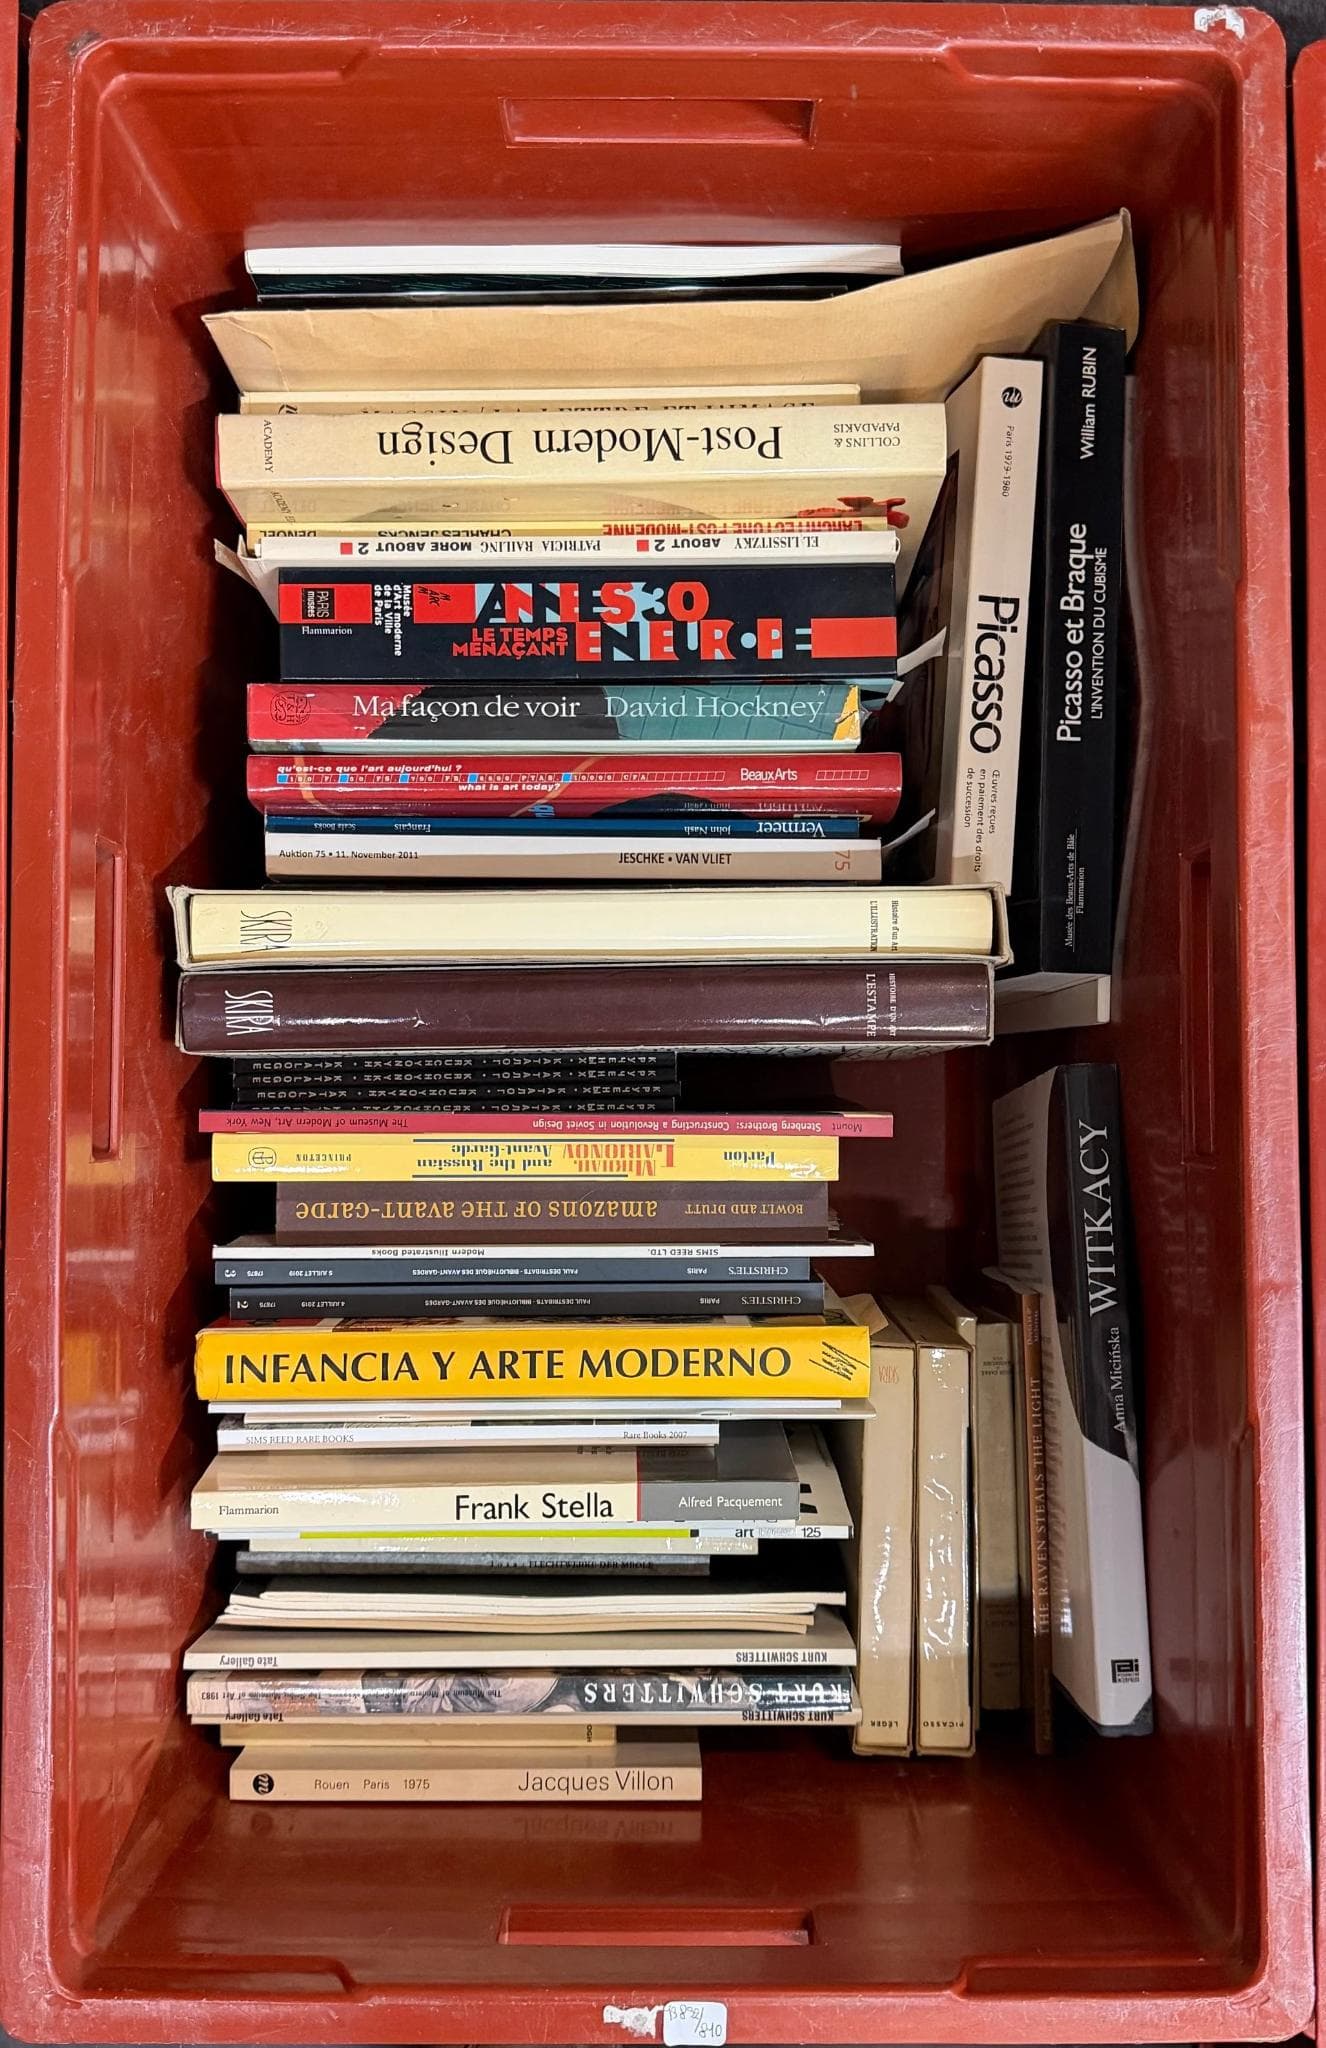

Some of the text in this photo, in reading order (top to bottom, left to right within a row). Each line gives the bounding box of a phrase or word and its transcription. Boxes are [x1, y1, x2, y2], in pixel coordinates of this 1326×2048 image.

[1080, 347, 1097, 459] William RUBIN
[833, 423, 900, 433] PAPADAKIS
[264, 419, 273, 473] ACADEMY
[376, 422, 783, 466] Post-Modern Design
[846, 437, 901, 448] COLLINS
[358, 542, 369, 555] 2
[375, 542, 425, 553] ABOUT
[428, 541, 472, 552] MORE
[542, 540, 601, 552] PATRICIA
[654, 539, 665, 552] 2
[672, 538, 721, 549] ABOUT
[734, 537, 799, 550] LISSITZKY
[801, 536, 819, 548] EL
[969, 425, 1020, 753] Paris 1979-1980 Picasso
[307, 591, 316, 618] musées
[316, 590, 330, 617] PARIS
[374, 600, 383, 626] Paris
[393, 584, 403, 657] d'Art moderne
[302, 626, 352, 636] Flammarion
[384, 612, 393, 635] Ville
[472, 627, 568, 641] LE TEMPS
[1056, 524, 1093, 741] Picasso et Braque
[1090, 548, 1107, 720] L'INVENTION DU CUBISME
[452, 642, 568, 660] MENAÇANT
[352, 693, 824, 723] Ma façon de voir David Hockney
[336, 766, 357, 774] que
[502, 783, 518, 791] art
[964, 782, 974, 828] succession
[987, 769, 1000, 834] Œuvres reçues
[394, 821, 826, 838] Vermeer John Nash Français
[974, 782, 986, 872] paiement droits
[279, 849, 418, 859] Auktion 75 11. November 2011
[618, 852, 732, 865] JESCHKE VAN VLIET
[833, 849, 850, 870] 75
[1065, 863, 1074, 904] Beaux-Arts
[1076, 867, 1085, 913] Flammarion
[240, 910, 292, 953] SKIRA
[225, 990, 274, 1035] SKIRA
[866, 973, 876, 1037] L'ESTAMPE
[226, 1118, 408, 1128] The Museum Modern Art, New York
[533, 1119, 862, 1132] Mount Stenberg Brothers: Constructing Revolution in Soviet Design
[295, 1154, 351, 1162] PRINCETON
[451, 1145, 552, 1157] Avant-Garde
[563, 1144, 675, 1168] LARIONOV
[723, 1151, 775, 1164] Parton
[417, 1158, 552, 1171] and the Russian
[760, 1204, 803, 1214] BOWLT
[1078, 1119, 1118, 1317] WITKACY
[372, 1249, 398, 1257] Books
[402, 1249, 449, 1257] Illustrated
[452, 1249, 484, 1257] Modern
[728, 1266, 788, 1275] CHRISTIE'S
[225, 1351, 419, 1384] INFANCIA
[432, 1351, 455, 1380] Y
[469, 1349, 564, 1379] ARTE
[578, 1347, 791, 1378] MODERNO
[1107, 1327, 1126, 1433] Anna Micińska
[1030, 1376, 1049, 1595] RAVEN STEALS THE LIGHT
[219, 1492, 782, 1520] Flammarion Frank Stella Alfred Pacquement
[735, 1527, 754, 1538] art
[801, 1527, 821, 1537] 125
[219, 1652, 827, 1667] KURT SCHWITTERS Tate Gallery
[583, 1682, 762, 1703] SCHWITTERS
[314, 1771, 674, 1797] Rouen Paris 1975 Jacques Villon
